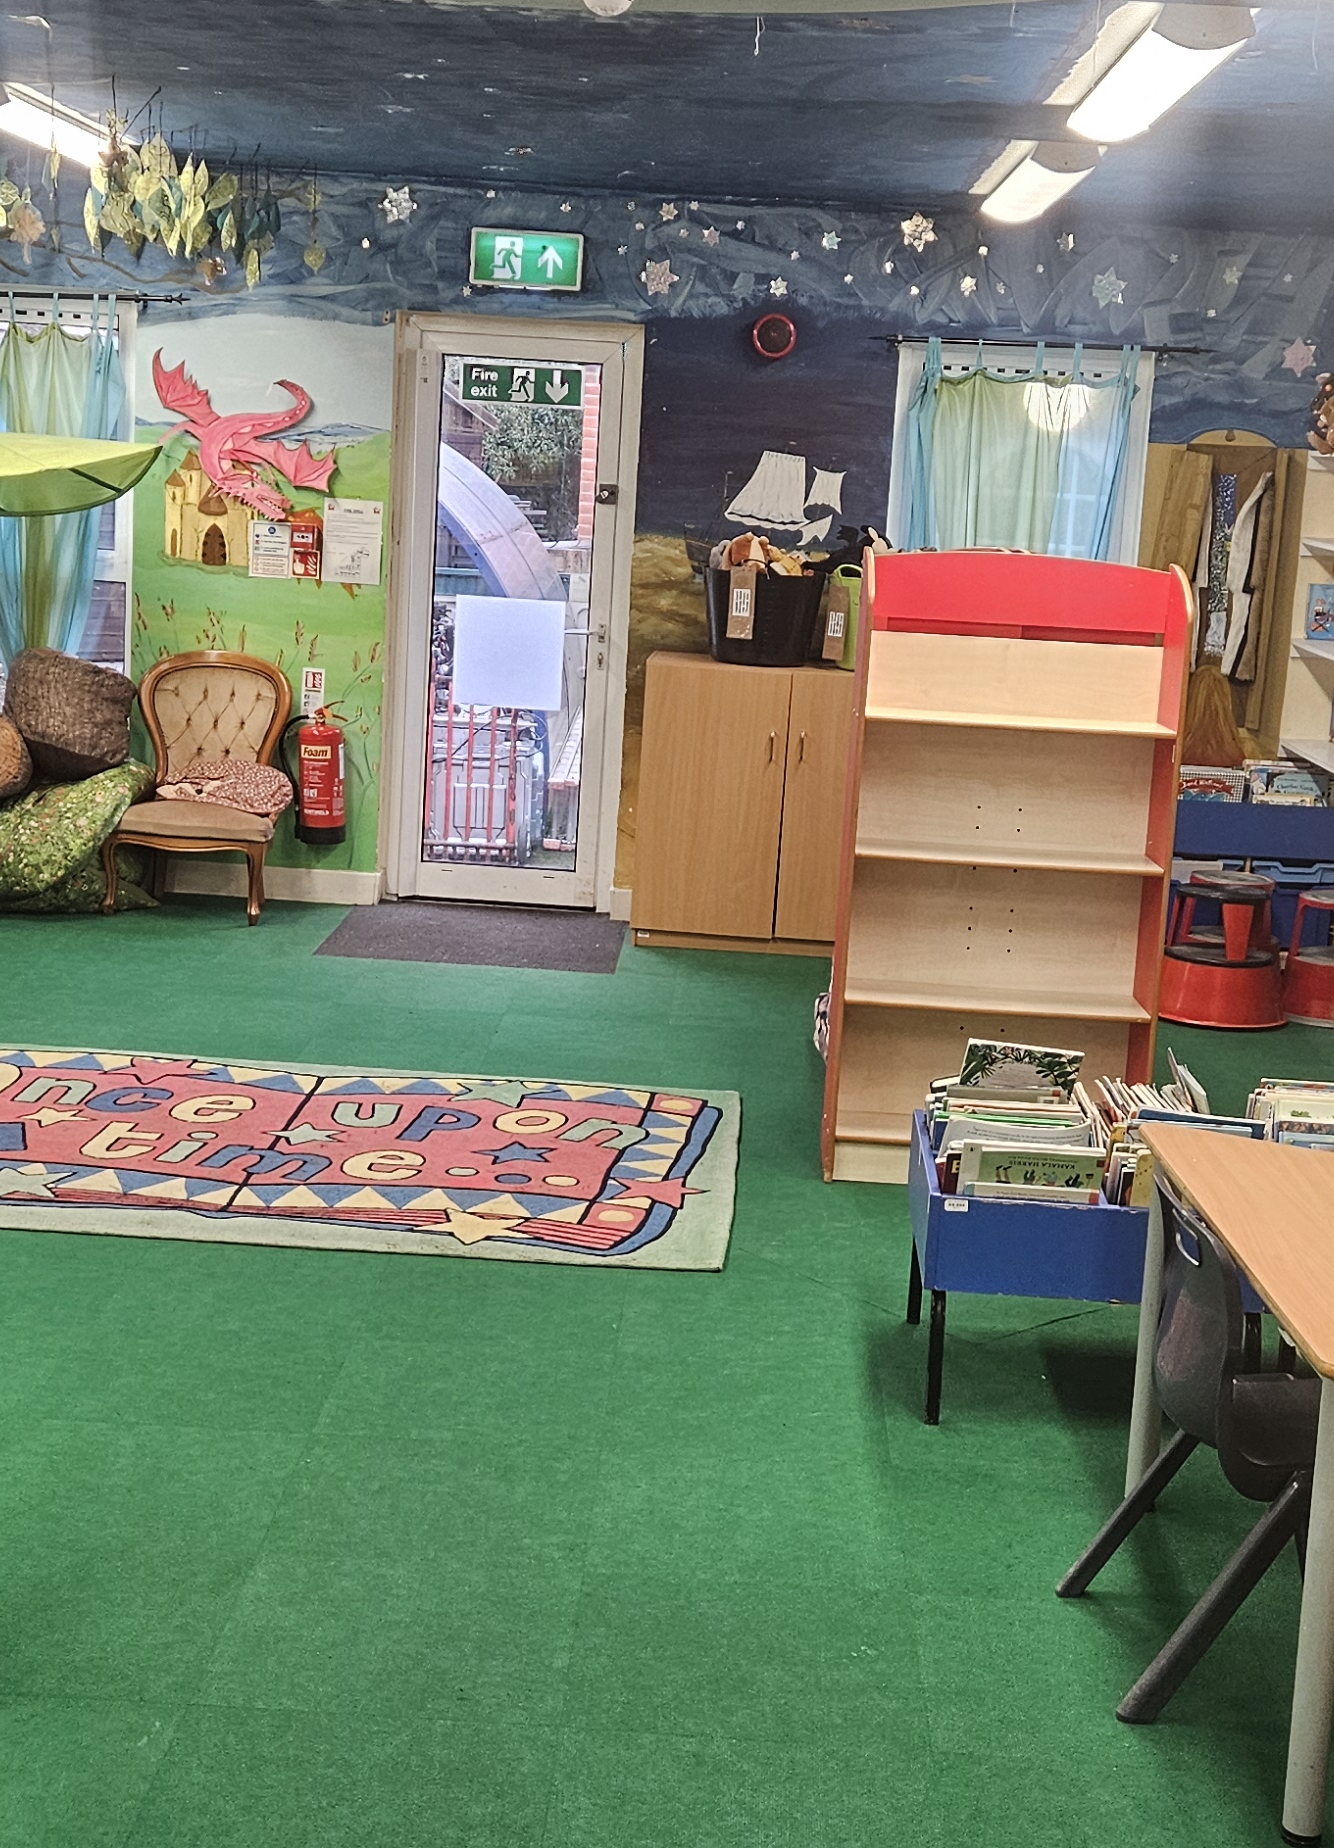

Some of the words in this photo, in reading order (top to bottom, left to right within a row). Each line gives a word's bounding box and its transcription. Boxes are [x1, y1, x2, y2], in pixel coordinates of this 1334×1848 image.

[471, 367, 499, 382] Fire
[470, 384, 498, 398] exit
[303, 747, 328, 757] Foam
[331, 1101, 650, 1149] upon
[1009, 1159, 1039, 1168] HARRIS
[1042, 1161, 1076, 1170] KAMALA
